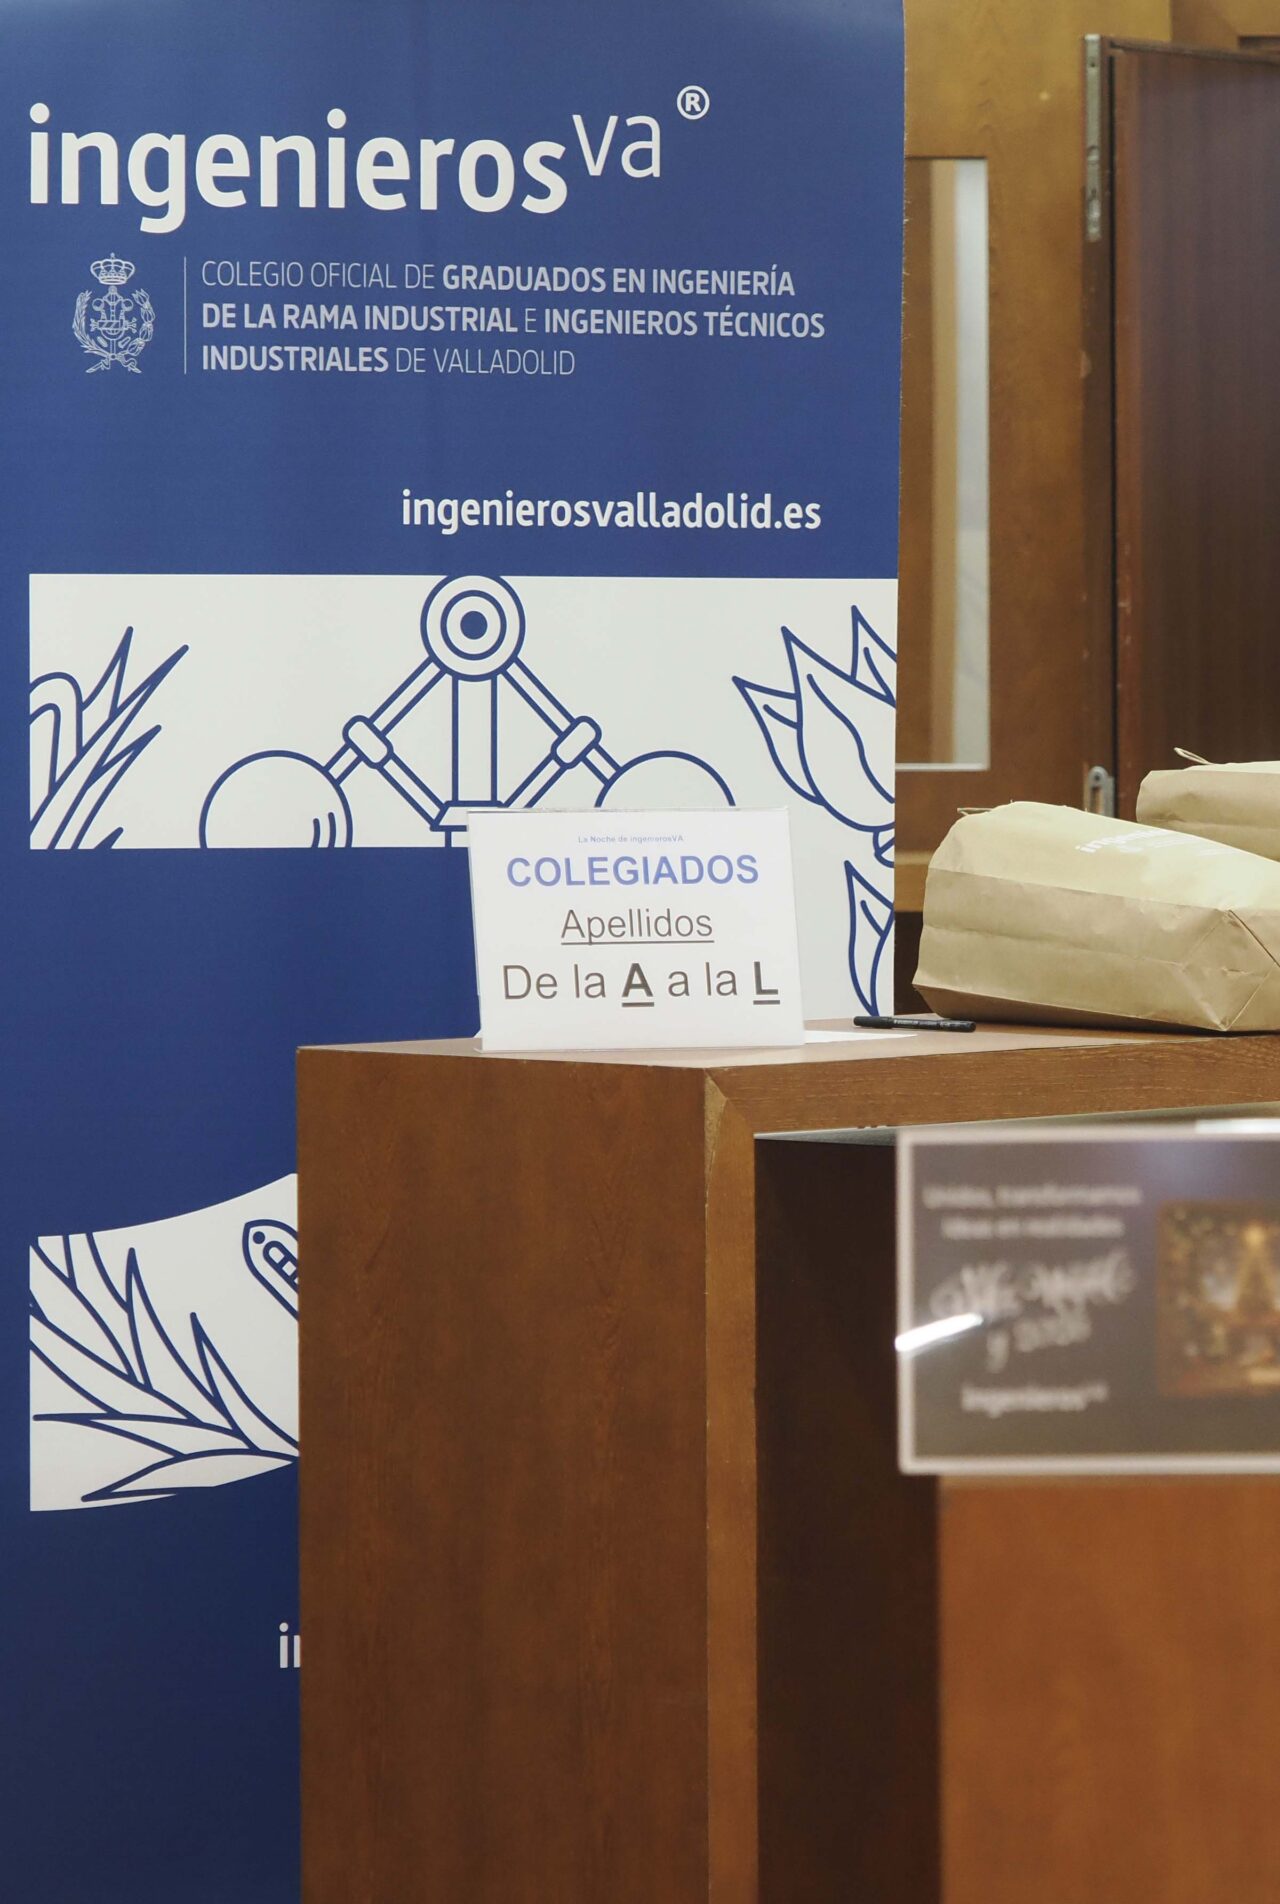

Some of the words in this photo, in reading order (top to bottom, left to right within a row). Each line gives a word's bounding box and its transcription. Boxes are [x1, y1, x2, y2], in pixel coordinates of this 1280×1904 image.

[201, 260, 304, 288] COLEGIO
[310, 261, 398, 289] OFICIAL
[404, 263, 436, 290] DE
[442, 264, 607, 293] GRADUADOS
[612, 267, 646, 294] EN
[652, 263, 797, 297] INGENIERÍA
[202, 302, 237, 329] DE
[243, 303, 277, 330] LA
[283, 303, 359, 330] RAMA
[364, 304, 519, 333] INDUSTRIAL
[524, 307, 537, 334] E
[544, 308, 698, 336] INGENIEROS
[703, 303, 826, 338] TÉCNICOS
[202, 344, 390, 373] INDUSTRIALES
[395, 346, 427, 374] DE
[432, 347, 576, 376] VALLADOLID
[401, 488, 822, 536] ingenierosvalladolid.es
[506, 854, 760, 887] COLEGIADOS
[560, 907, 714, 946] Apellidos
[502, 963, 559, 1000] De
[573, 963, 607, 999] la
[621, 962, 654, 998] A
[667, 970, 690, 998] a
[705, 961, 738, 997] la
[753, 960, 780, 996] L
